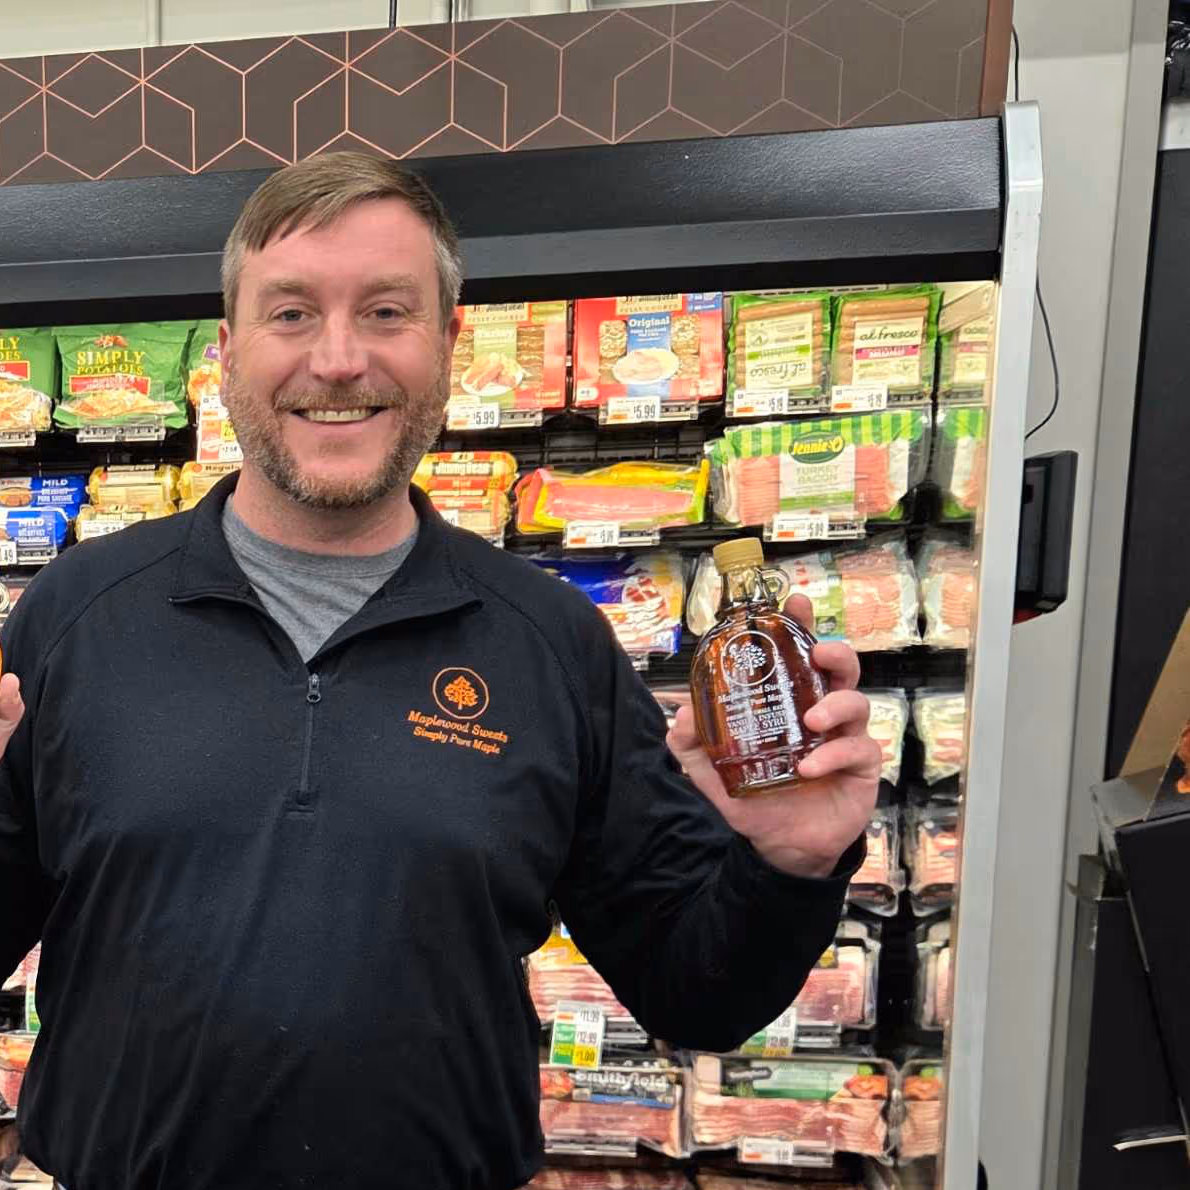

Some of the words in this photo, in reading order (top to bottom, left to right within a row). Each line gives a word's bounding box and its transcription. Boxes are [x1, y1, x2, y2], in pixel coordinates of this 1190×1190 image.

[628, 316, 670, 328] Original
[77, 351, 145, 366] SIMPLY
[77, 364, 144, 375] POTATOES
[408, 710, 470, 733] Maplewood
[472, 724, 508, 743] Sweets
[413, 726, 448, 744] Simply
[450, 733, 471, 747] Pure
[472, 739, 501, 755] Maple
[569, 1070, 667, 1092] Smithfield
